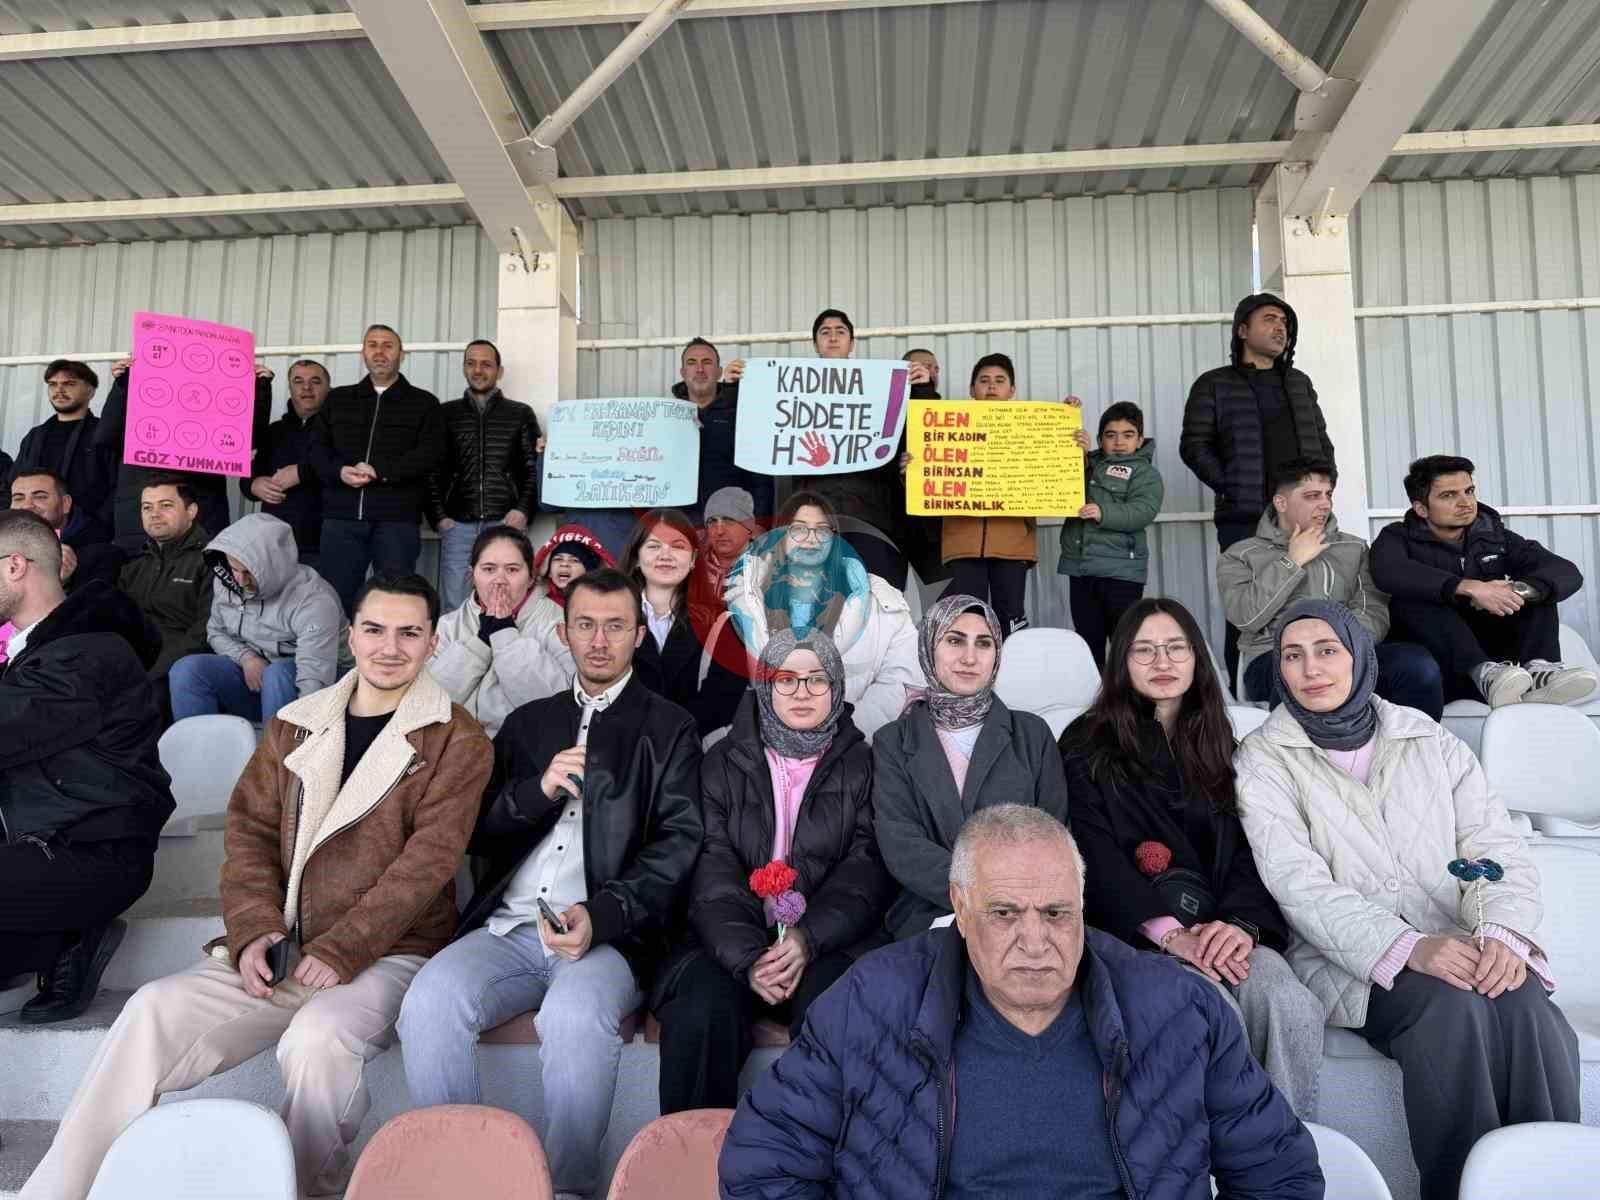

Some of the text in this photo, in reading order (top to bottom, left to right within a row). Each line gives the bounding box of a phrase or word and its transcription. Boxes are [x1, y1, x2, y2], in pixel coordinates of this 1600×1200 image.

[775, 396, 872, 433] ŞİDDETE
[922, 407, 970, 428] ÖLEN
[948, 431, 987, 442] KADIN
[134, 448, 171, 466] GÖZ
[923, 443, 968, 463] ÖLEN
[922, 479, 967, 497] ÖLEN
